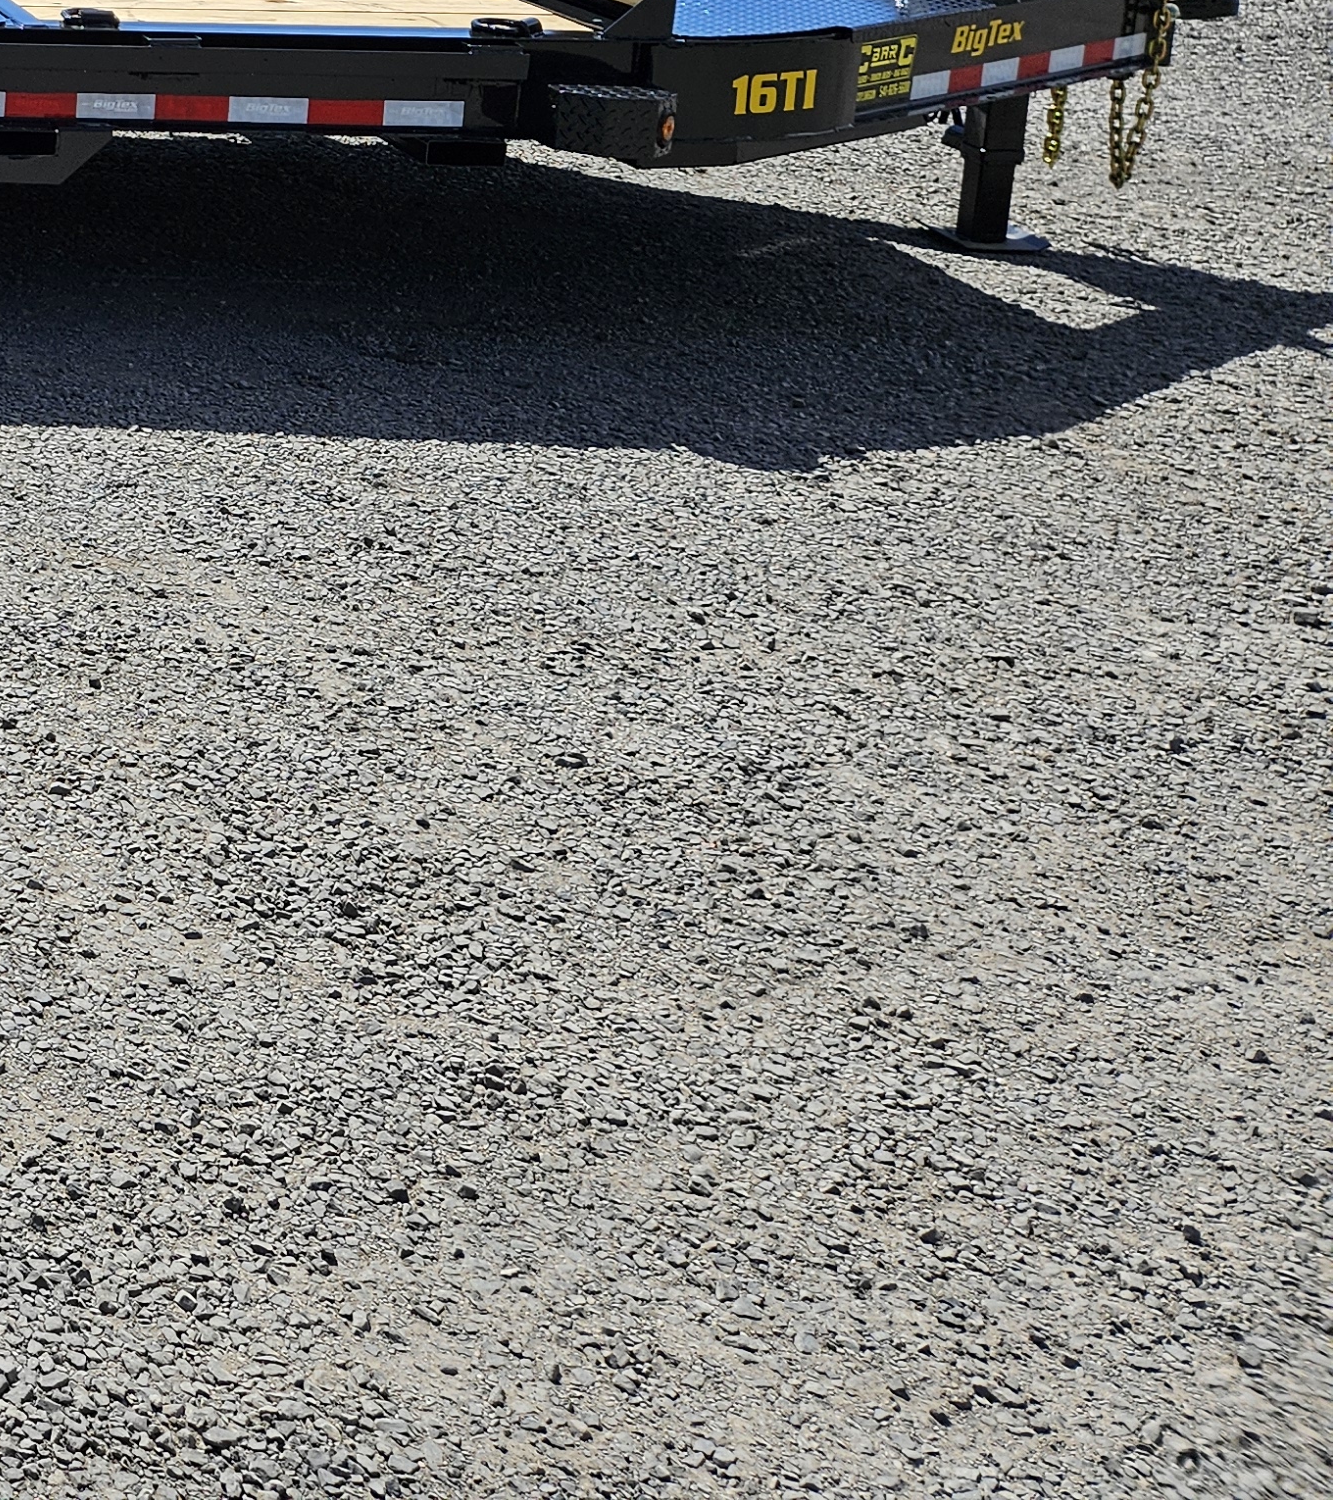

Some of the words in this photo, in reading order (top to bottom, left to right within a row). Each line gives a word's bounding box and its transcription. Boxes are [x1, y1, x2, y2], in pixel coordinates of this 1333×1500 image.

[871, 44, 899, 62] BAR
[898, 36, 917, 66] C
[951, 18, 1025, 57] BigTex
[93, 99, 138, 112] BigTex
[732, 69, 818, 116] 16TI
[245, 102, 291, 115] BigTex
